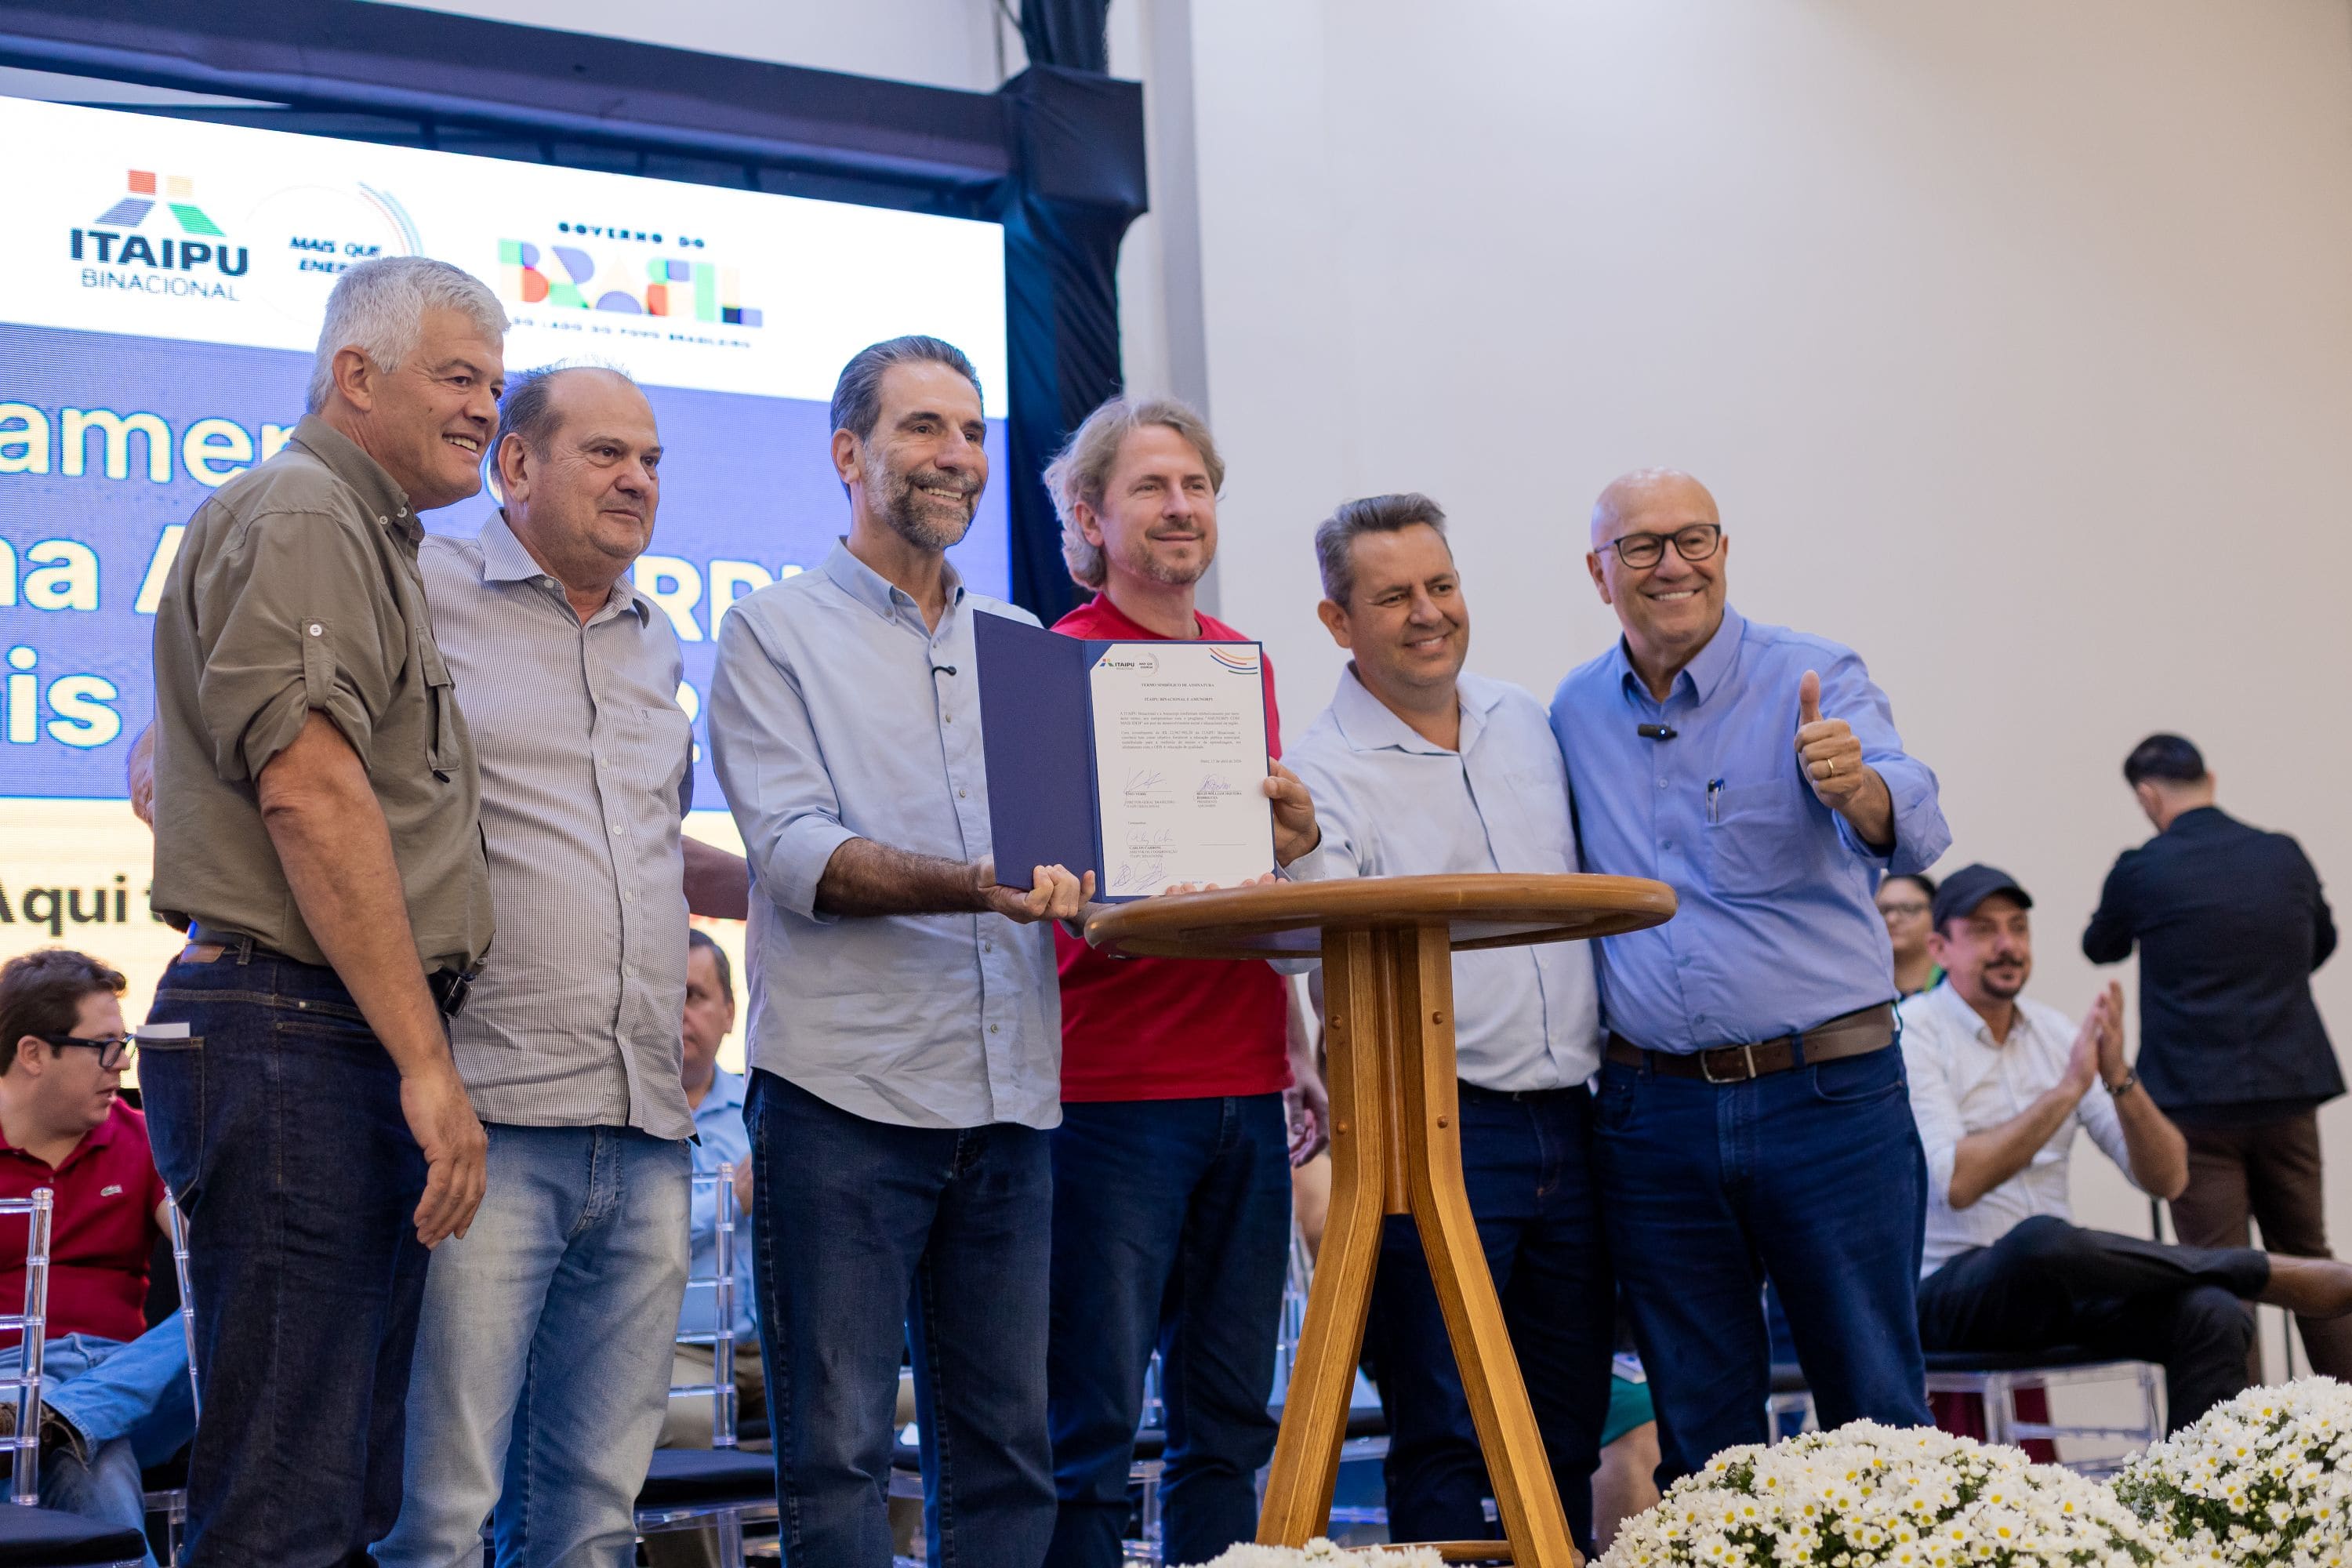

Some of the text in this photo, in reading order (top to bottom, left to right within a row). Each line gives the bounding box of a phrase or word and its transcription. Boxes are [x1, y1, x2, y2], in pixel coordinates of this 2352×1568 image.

[71, 227, 249, 278] ITAIPU
[289, 236, 383, 258] MAIS QUE
[299, 258, 350, 275] ENER
[499, 238, 763, 328] BRASIL
[81, 267, 241, 302] BINACIONAL
